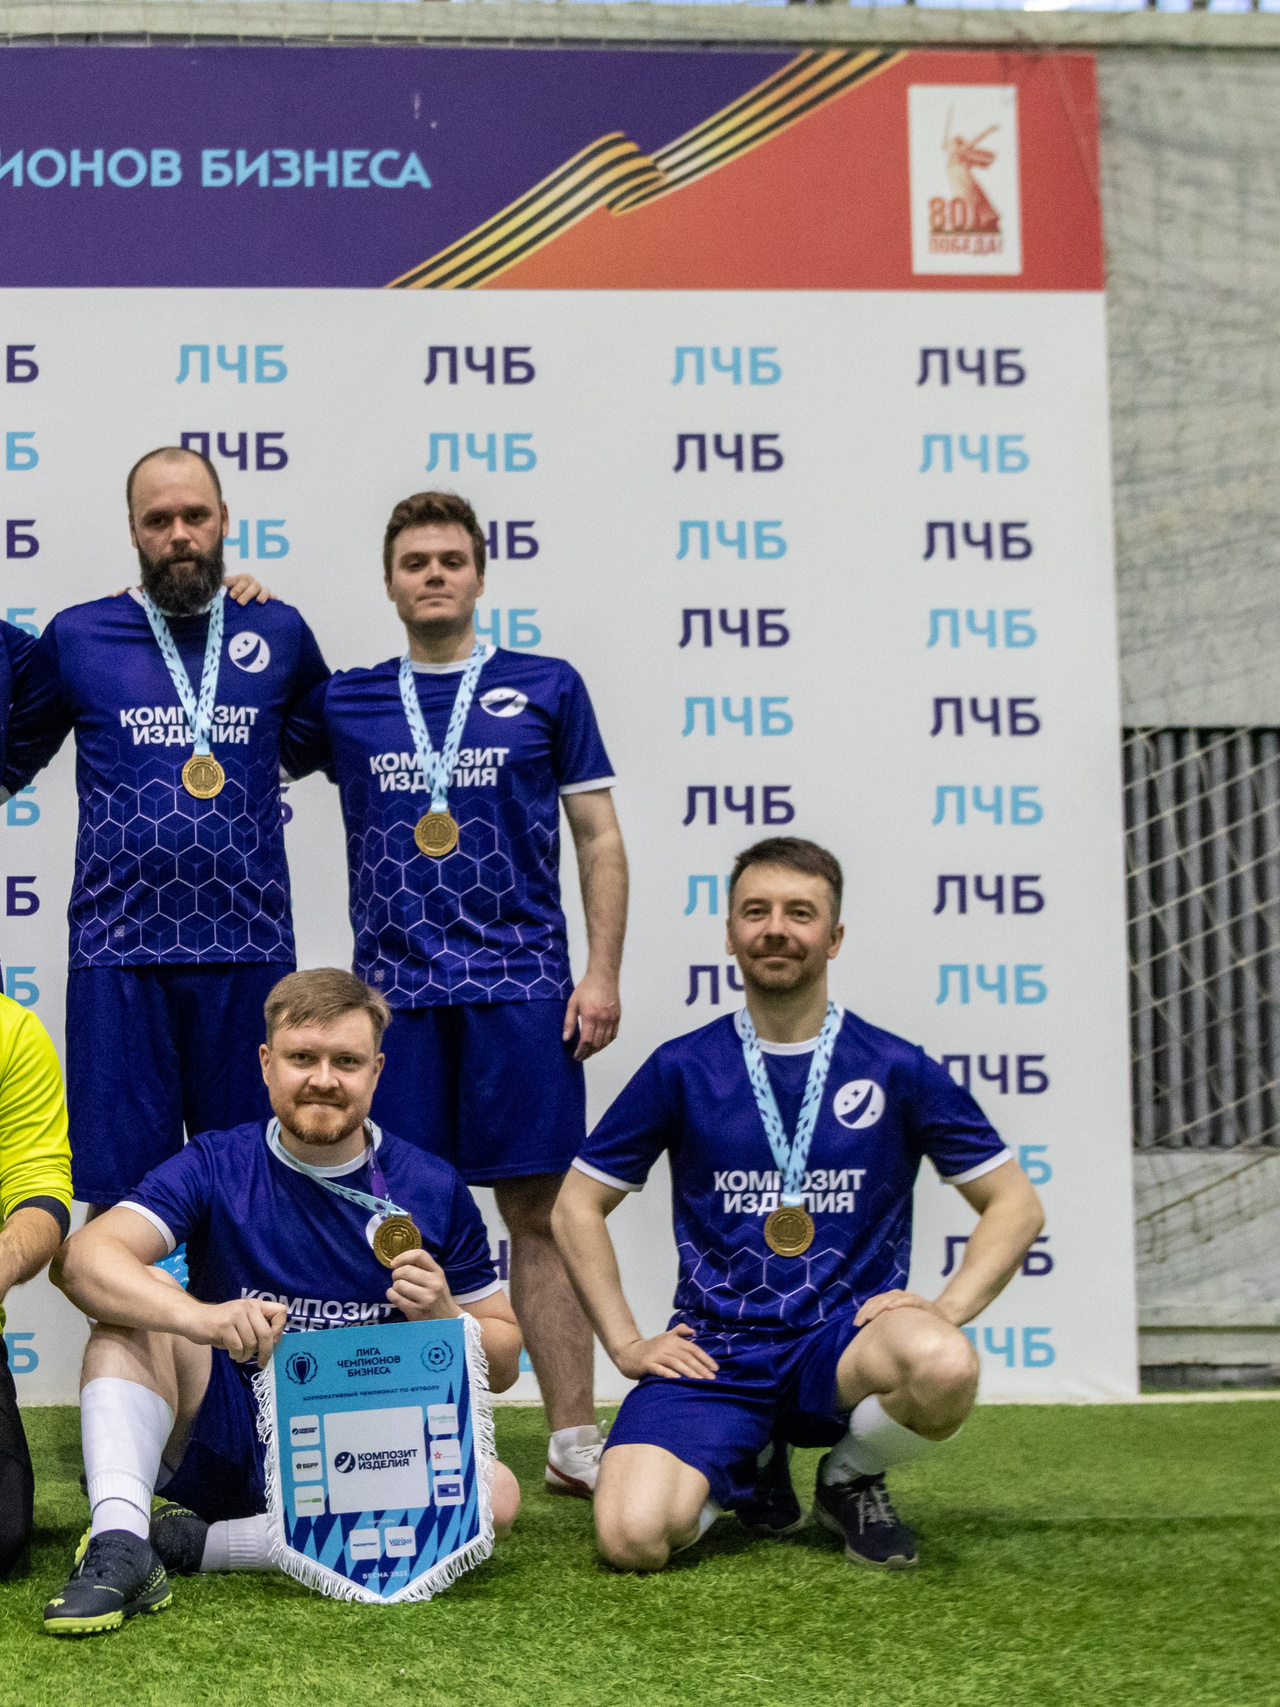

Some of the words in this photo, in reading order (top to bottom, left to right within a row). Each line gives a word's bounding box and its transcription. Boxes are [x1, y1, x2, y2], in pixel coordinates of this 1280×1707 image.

[201, 149, 432, 189] БИЗНЕСА
[176, 344, 288, 384] ЛЧБ
[424, 346, 536, 385] ЛЧБ
[672, 347, 781, 385] ЛЧБ
[917, 347, 1026, 387] ЛЧБ
[425, 433, 537, 472] ЛЧБ
[673, 433, 784, 473] ЛЧБ
[920, 434, 1029, 473] ЛЧБ
[223, 519, 290, 559] ЧБ
[676, 520, 787, 560] ЛЧБ
[922, 521, 1033, 561] ЛЧБ
[473, 608, 542, 648] ЧБ
[678, 608, 790, 649] ЛЧБ
[927, 609, 1036, 648] ЛЧБ
[682, 696, 793, 737] ЛЧБ
[930, 697, 1041, 737] ЛЧБ
[379, 768, 498, 794] ИЗДЛИЯ
[682, 785, 795, 827] ЛЧБ
[932, 786, 1043, 825] ЛЧБ
[933, 874, 1045, 915] ЛЧБ
[936, 964, 1047, 1005] ЛЧБ
[723, 1191, 855, 1216] ИЗДЛИЯ
[940, 1236, 1053, 1277] ЛБ
[337, 1355, 401, 1369] ЧЕМПИОНОВ
[347, 1366, 391, 1378] БИЗНЕСА
[356, 1347, 381, 1357] ЛИГА
[303, 1391, 358, 1401] КОРПОРАТИВНЫЙ
[360, 1388, 398, 1396] ЧЕМПИОНАТ
[357, 1449, 418, 1462] КОМПОЗИТ
[358, 1458, 410, 1471] ИЗДЕЛИЯ
